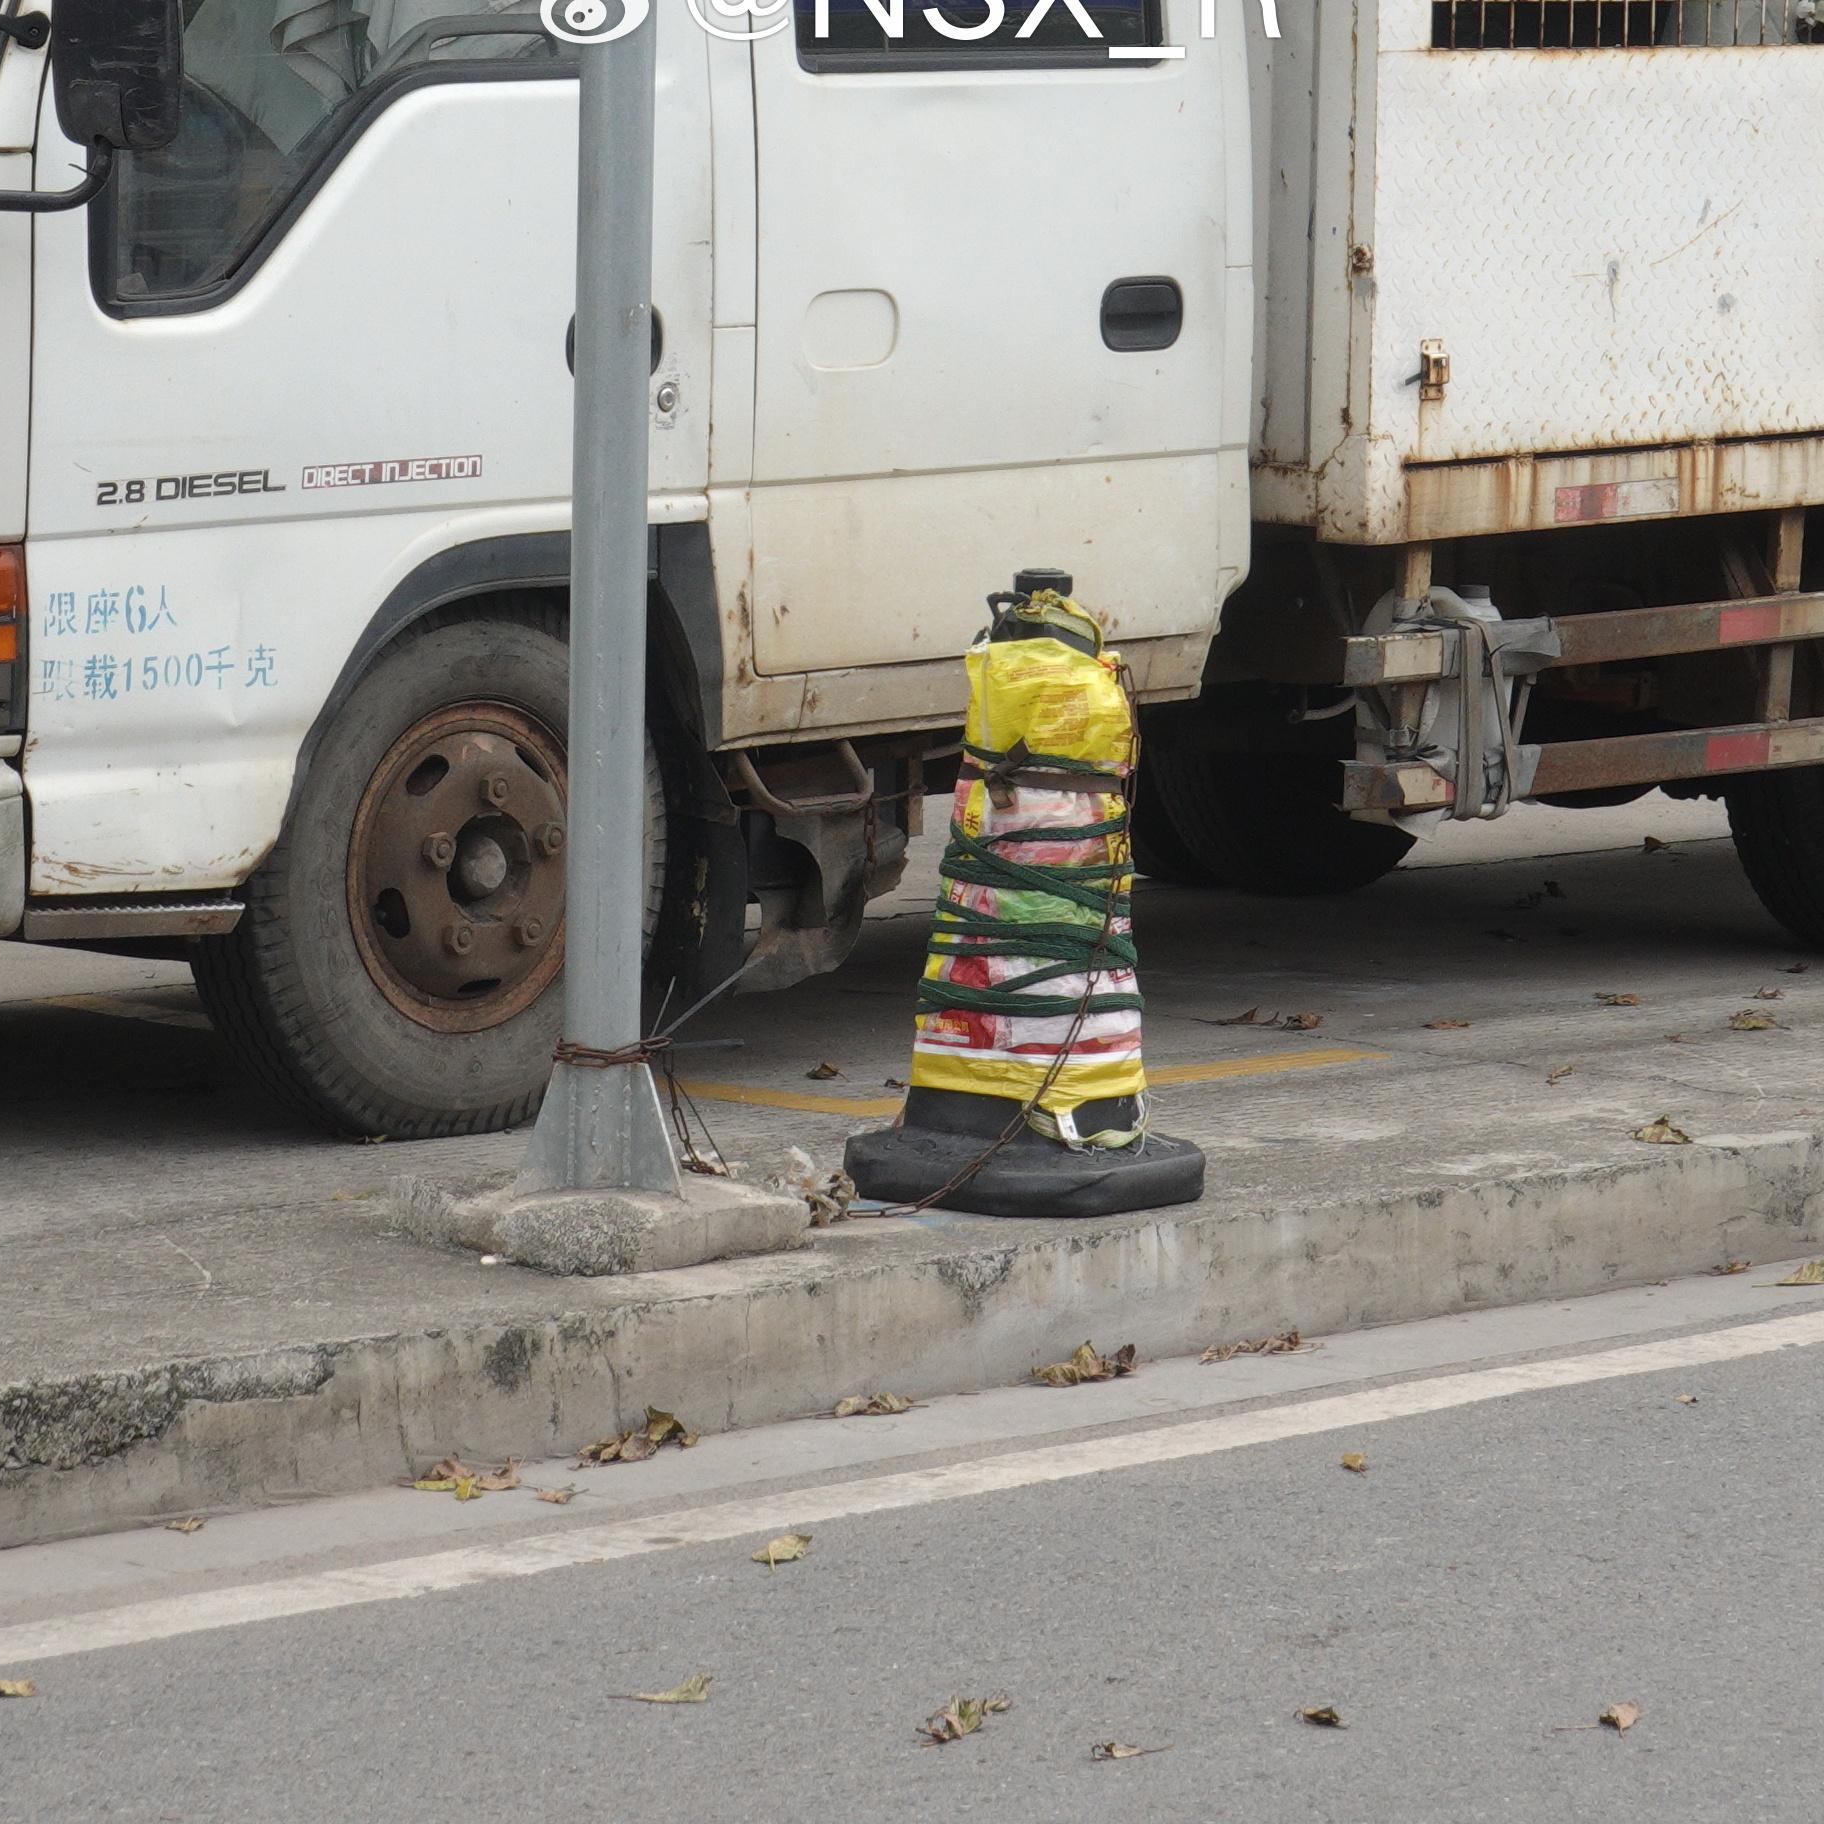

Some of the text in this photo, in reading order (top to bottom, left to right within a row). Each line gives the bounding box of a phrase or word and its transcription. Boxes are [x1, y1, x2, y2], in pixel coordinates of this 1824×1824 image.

[96, 468, 287, 506] 2.8 DIESEL
[303, 455, 482, 488] DIRECT INJECTION
[43, 584, 178, 637] 限座6人
[38, 643, 279, 701] 限载1500千克
